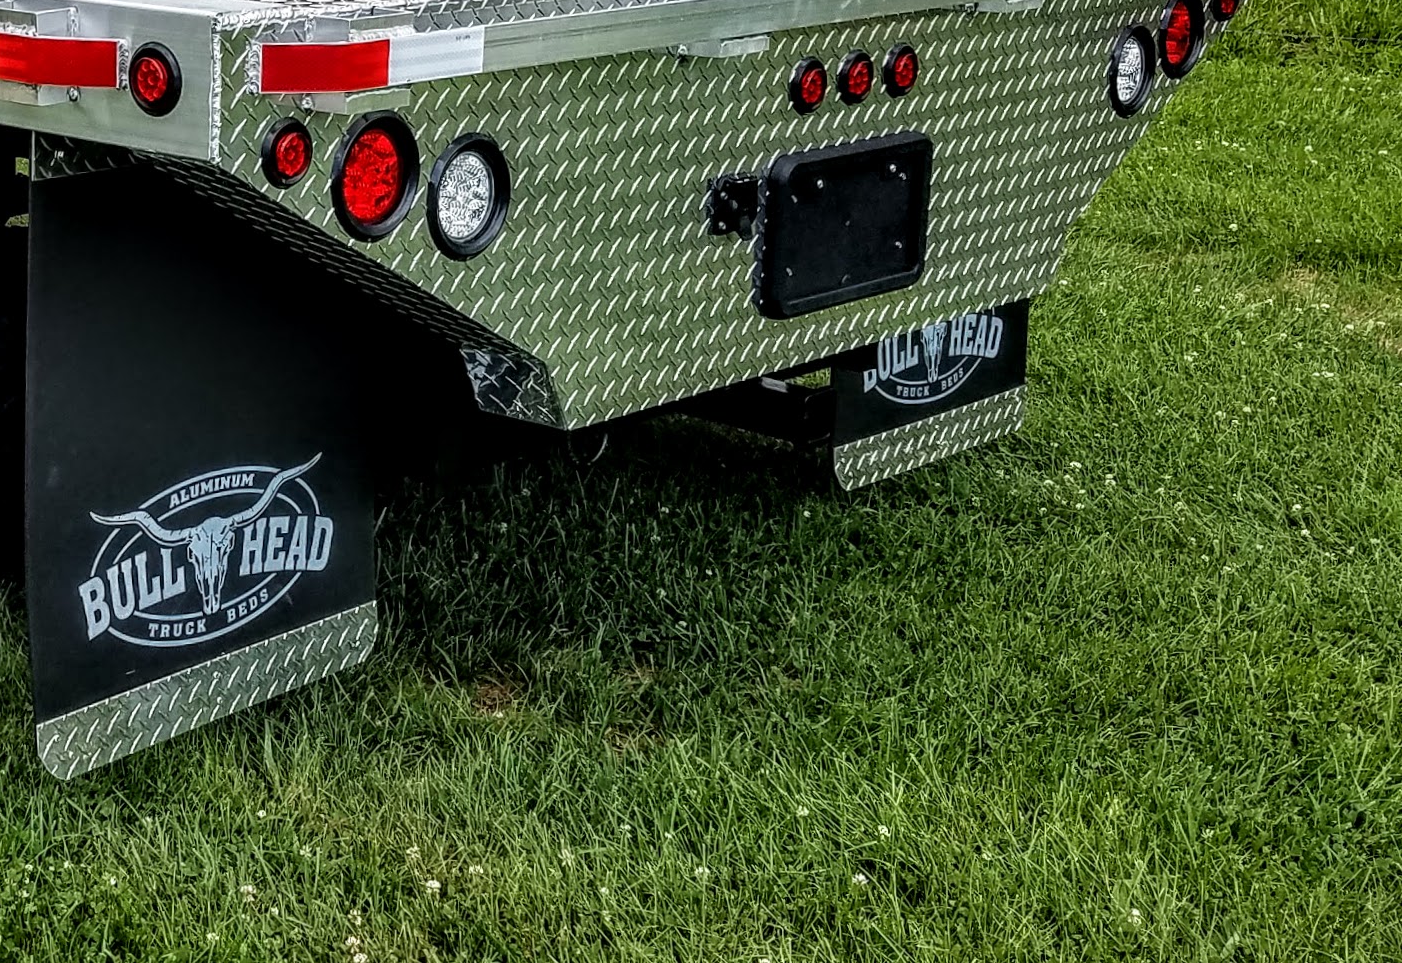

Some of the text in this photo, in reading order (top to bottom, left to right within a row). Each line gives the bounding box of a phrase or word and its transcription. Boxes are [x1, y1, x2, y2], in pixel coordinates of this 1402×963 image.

[949, 314, 1003, 358] HEAD
[896, 368, 964, 397] TRUCK BEDS
[169, 474, 254, 508] ALUMINUM
[78, 515, 333, 641] BULL HEAD
[148, 589, 268, 638] TRUCK BEDS
